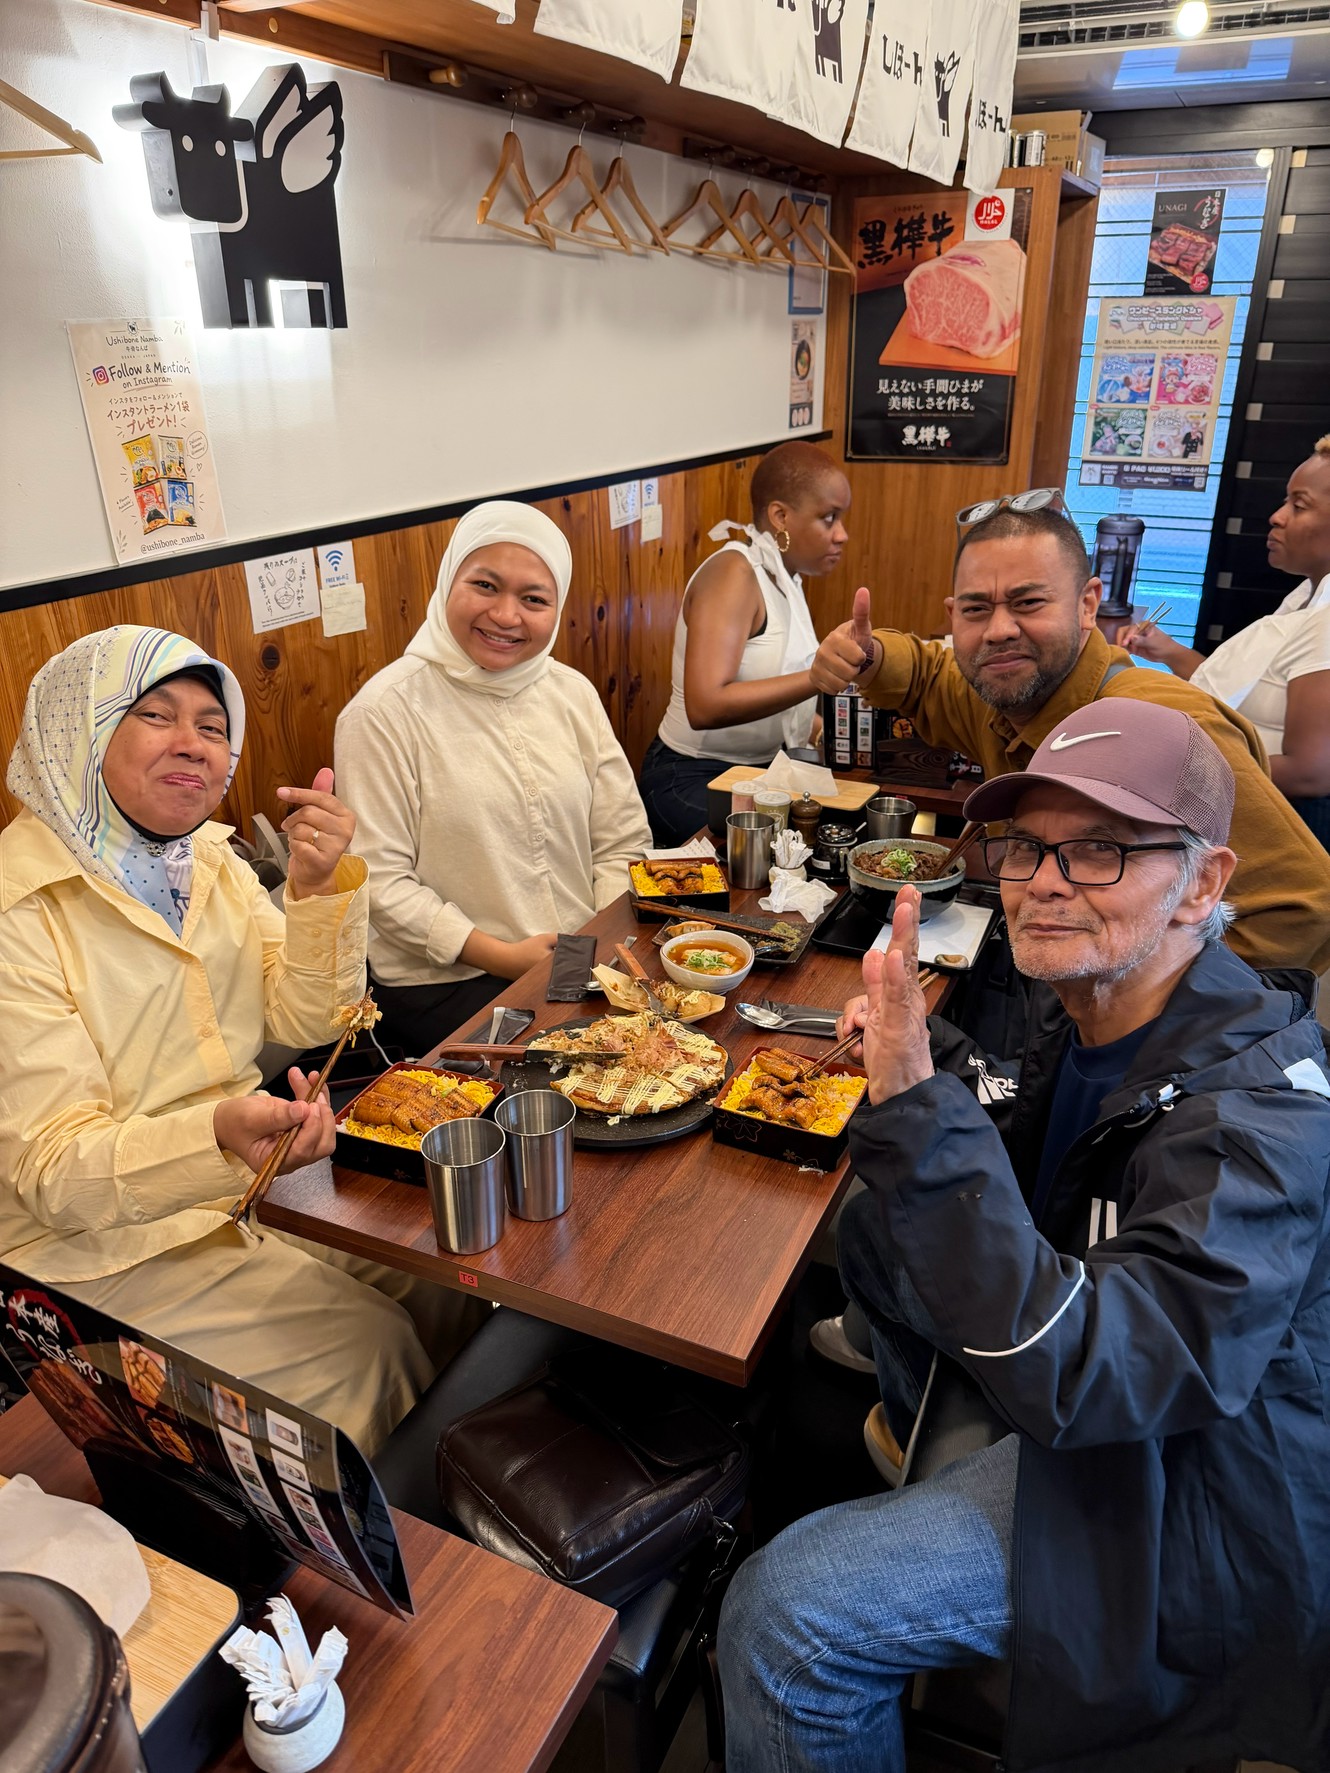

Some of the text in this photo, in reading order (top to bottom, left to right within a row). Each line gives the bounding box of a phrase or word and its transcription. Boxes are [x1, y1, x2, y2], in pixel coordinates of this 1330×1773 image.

[1158, 203, 1187, 212] UNAGI
[106, 335, 164, 346] Ushibone Namba
[108, 360, 191, 381] Follow & Mention
[122, 376, 173, 389] on Instagram
[876, 378, 984, 394] 見えない手間ひまが
[887, 395, 975, 411] 美味しさを作る。
[140, 532, 205, 555] @ushibone_namba
[461, 1273, 475, 1284] T3
[6, 1323, 102, 1385] うなぎ
